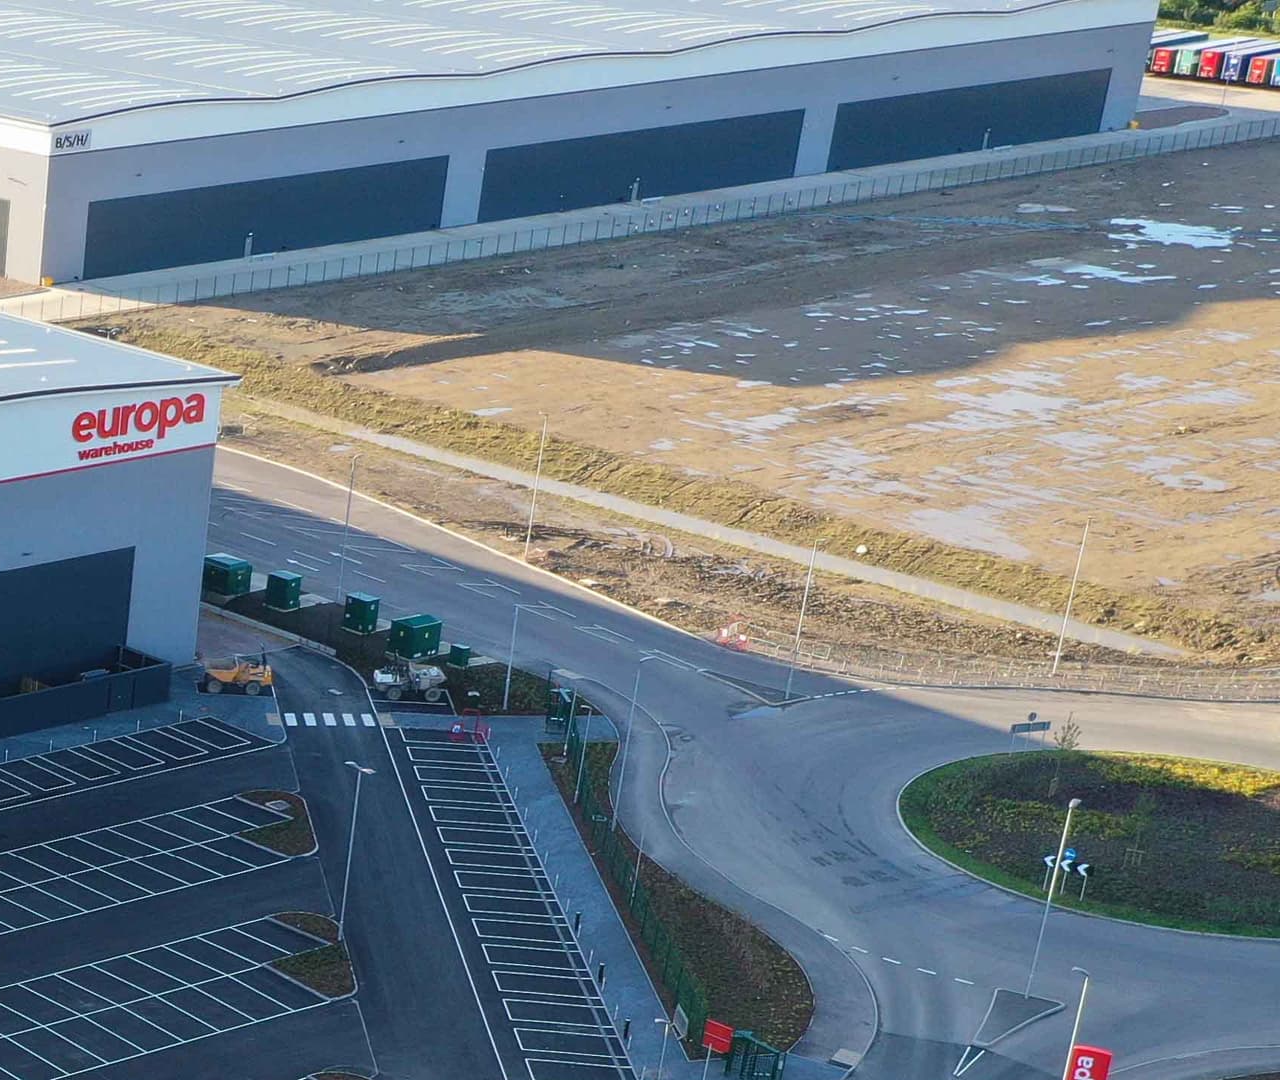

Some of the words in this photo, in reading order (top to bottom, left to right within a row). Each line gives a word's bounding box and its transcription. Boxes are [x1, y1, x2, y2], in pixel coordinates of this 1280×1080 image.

[55, 133, 89, 148] B/S/H/
[72, 393, 206, 443] europa
[78, 438, 154, 461] warehouse
